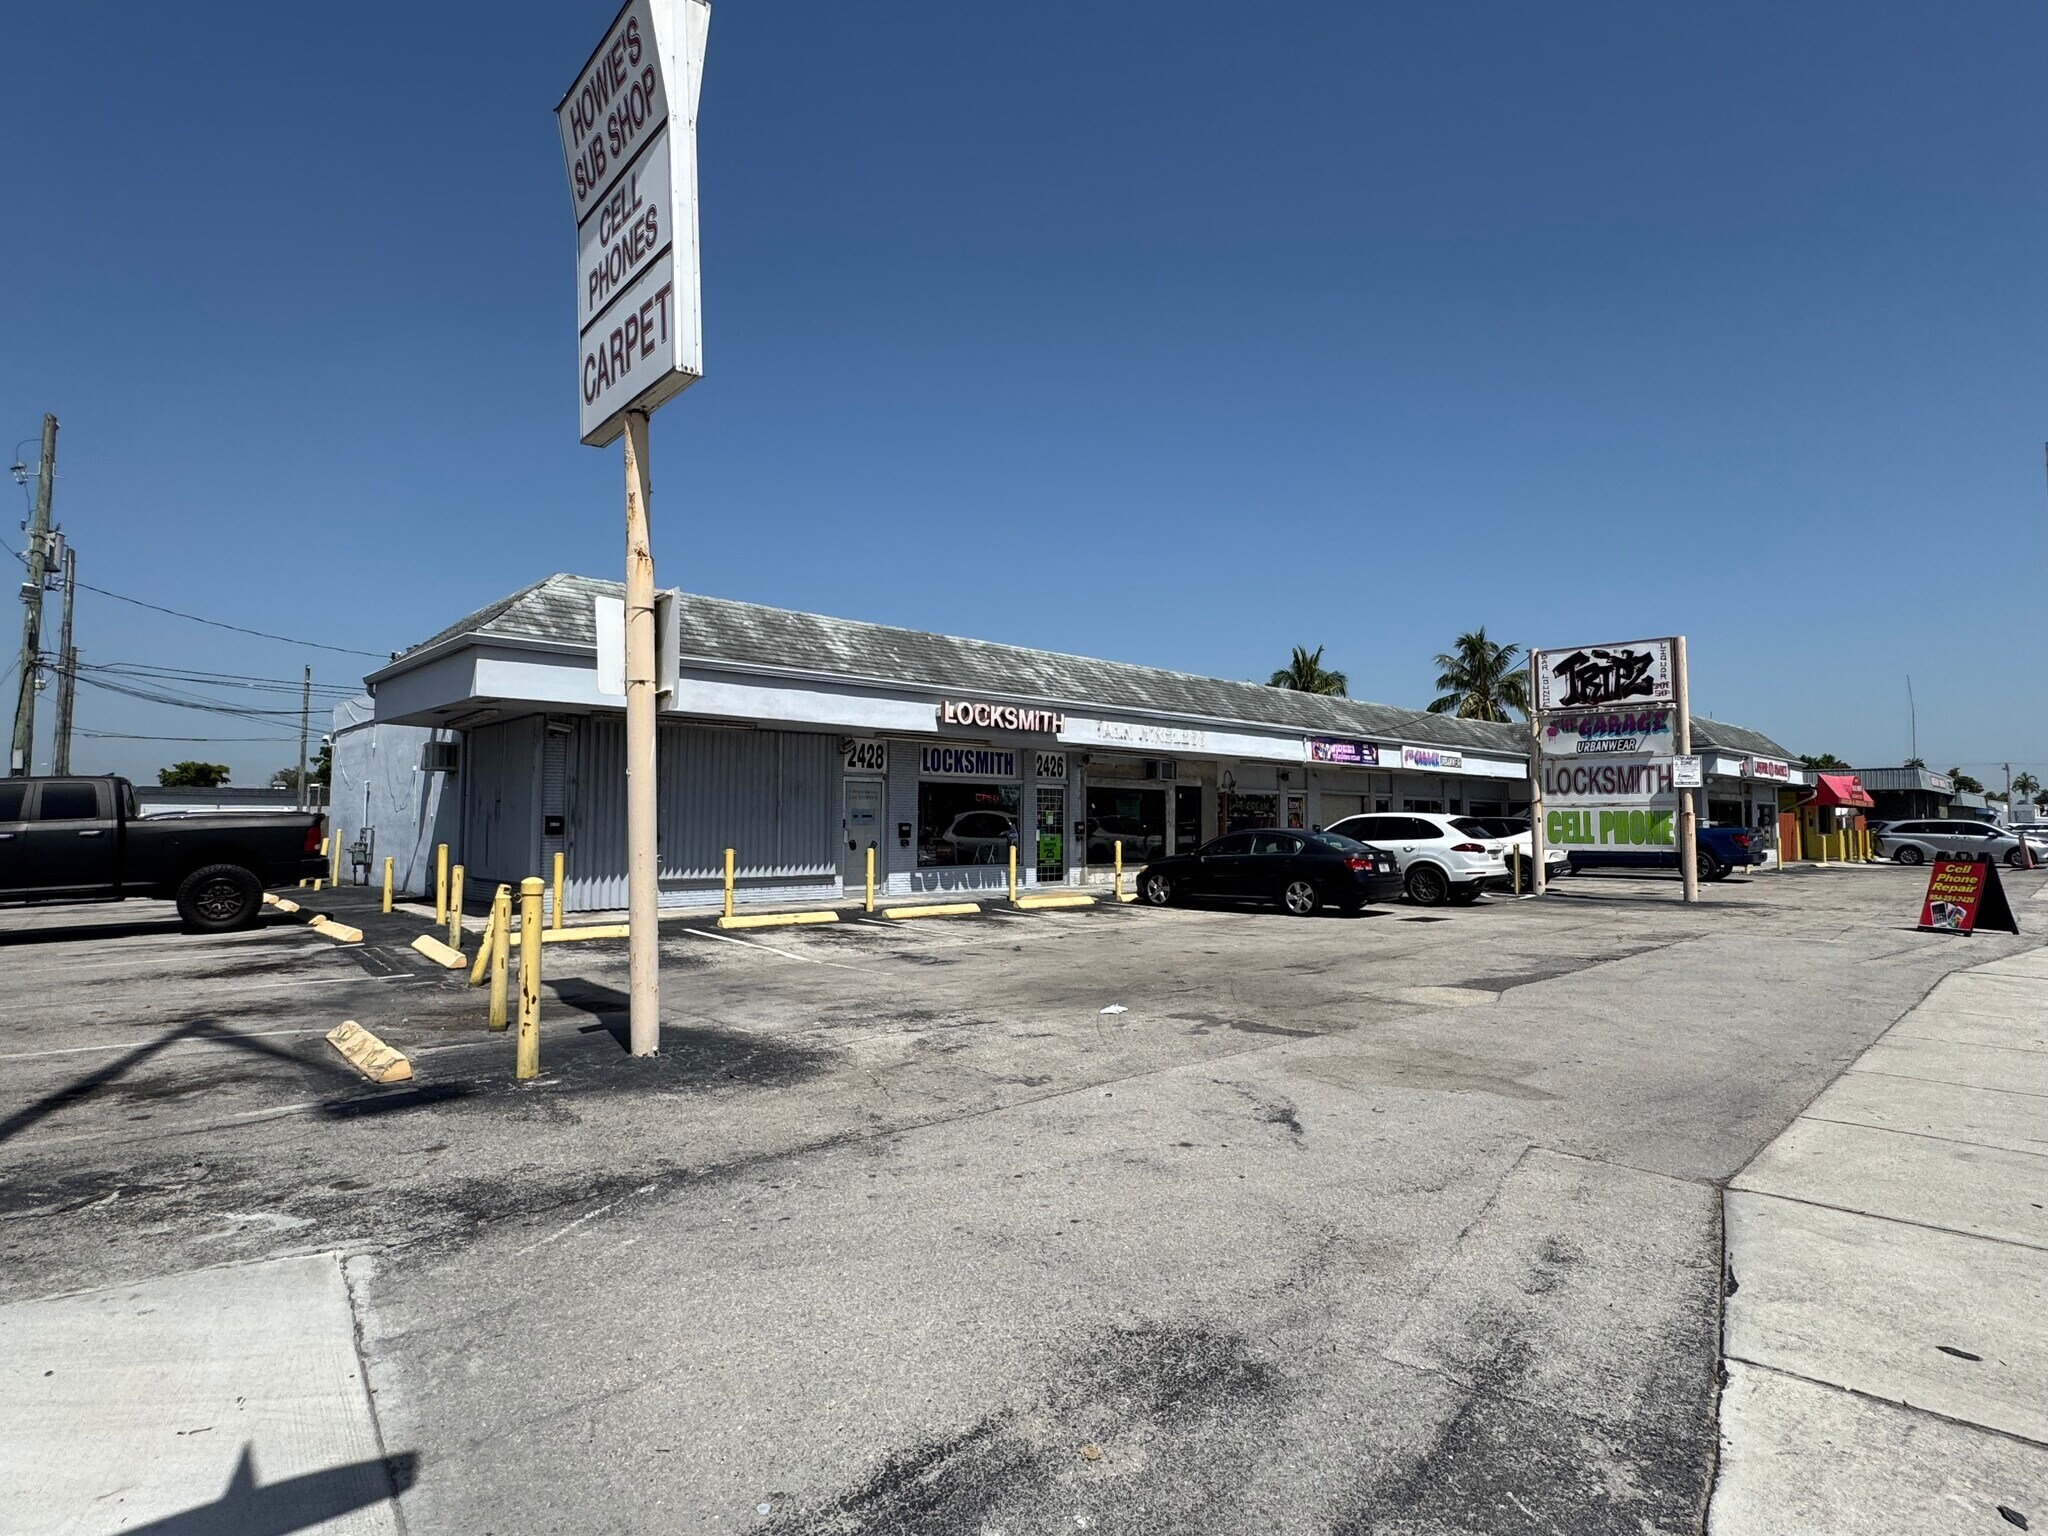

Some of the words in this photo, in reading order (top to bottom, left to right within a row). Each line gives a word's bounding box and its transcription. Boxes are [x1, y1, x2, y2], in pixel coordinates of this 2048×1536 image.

[569, 16, 642, 149] HOWIE'S
[574, 132, 606, 202] SUB
[607, 63, 657, 160] SHOP
[599, 171, 643, 248] CELL
[588, 204, 658, 312] PHONES
[583, 281, 671, 406] CARPET
[941, 700, 1066, 734] LOCKSMITH
[1578, 711, 1670, 738] GARAGE
[847, 741, 884, 769] 2428
[1577, 739, 1636, 753] URBANWEAR
[922, 747, 1014, 775] LOCKSMITH
[1036, 754, 1064, 777] 2426
[1545, 763, 1674, 794] LOCKSMITH
[1547, 810, 1595, 845] CELL
[1600, 810, 1675, 845] PHONE
[1936, 873, 1978, 883] Phone
[1945, 864, 1972, 873] Cell
[1932, 882, 1977, 893] Repair
